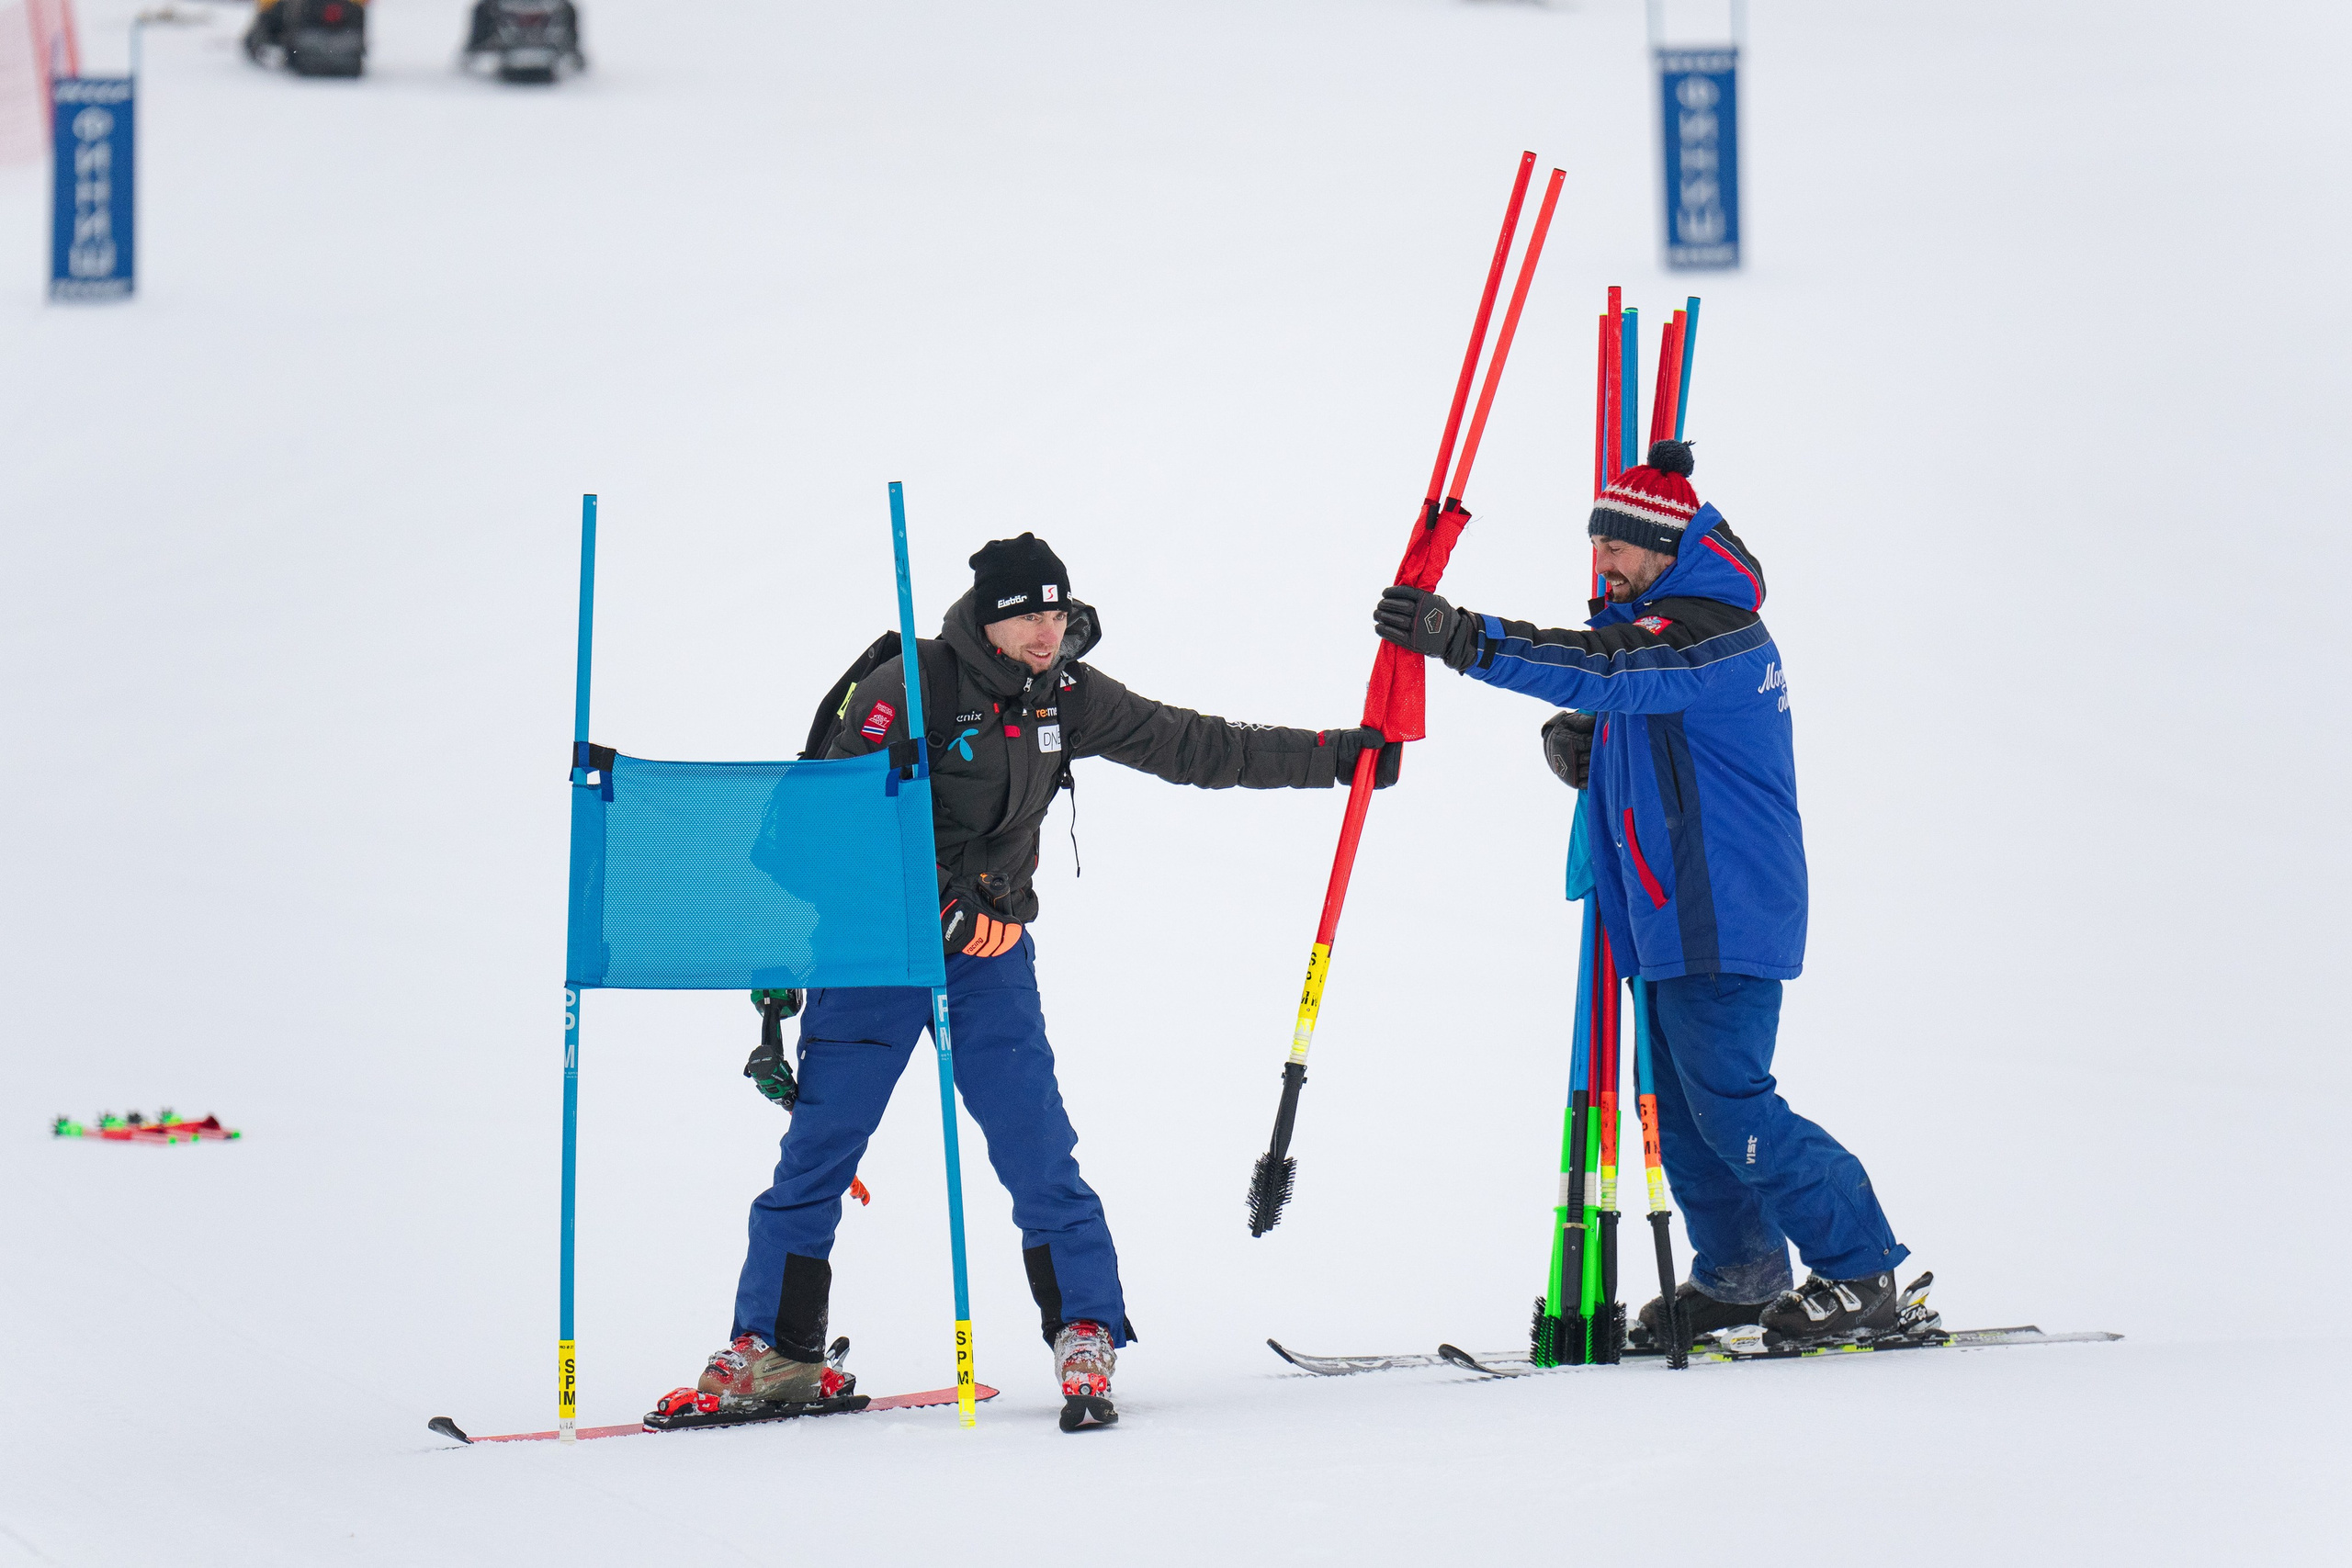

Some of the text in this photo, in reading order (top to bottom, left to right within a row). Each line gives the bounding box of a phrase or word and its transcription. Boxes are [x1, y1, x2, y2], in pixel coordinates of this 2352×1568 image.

[1675, 77, 1727, 244] ФИНИШ
[70, 106, 118, 277] ФИНИШ
[997, 594, 1028, 609] Eisbär
[967, 937, 985, 953] racing
[564, 1359, 575, 1405] SPM
